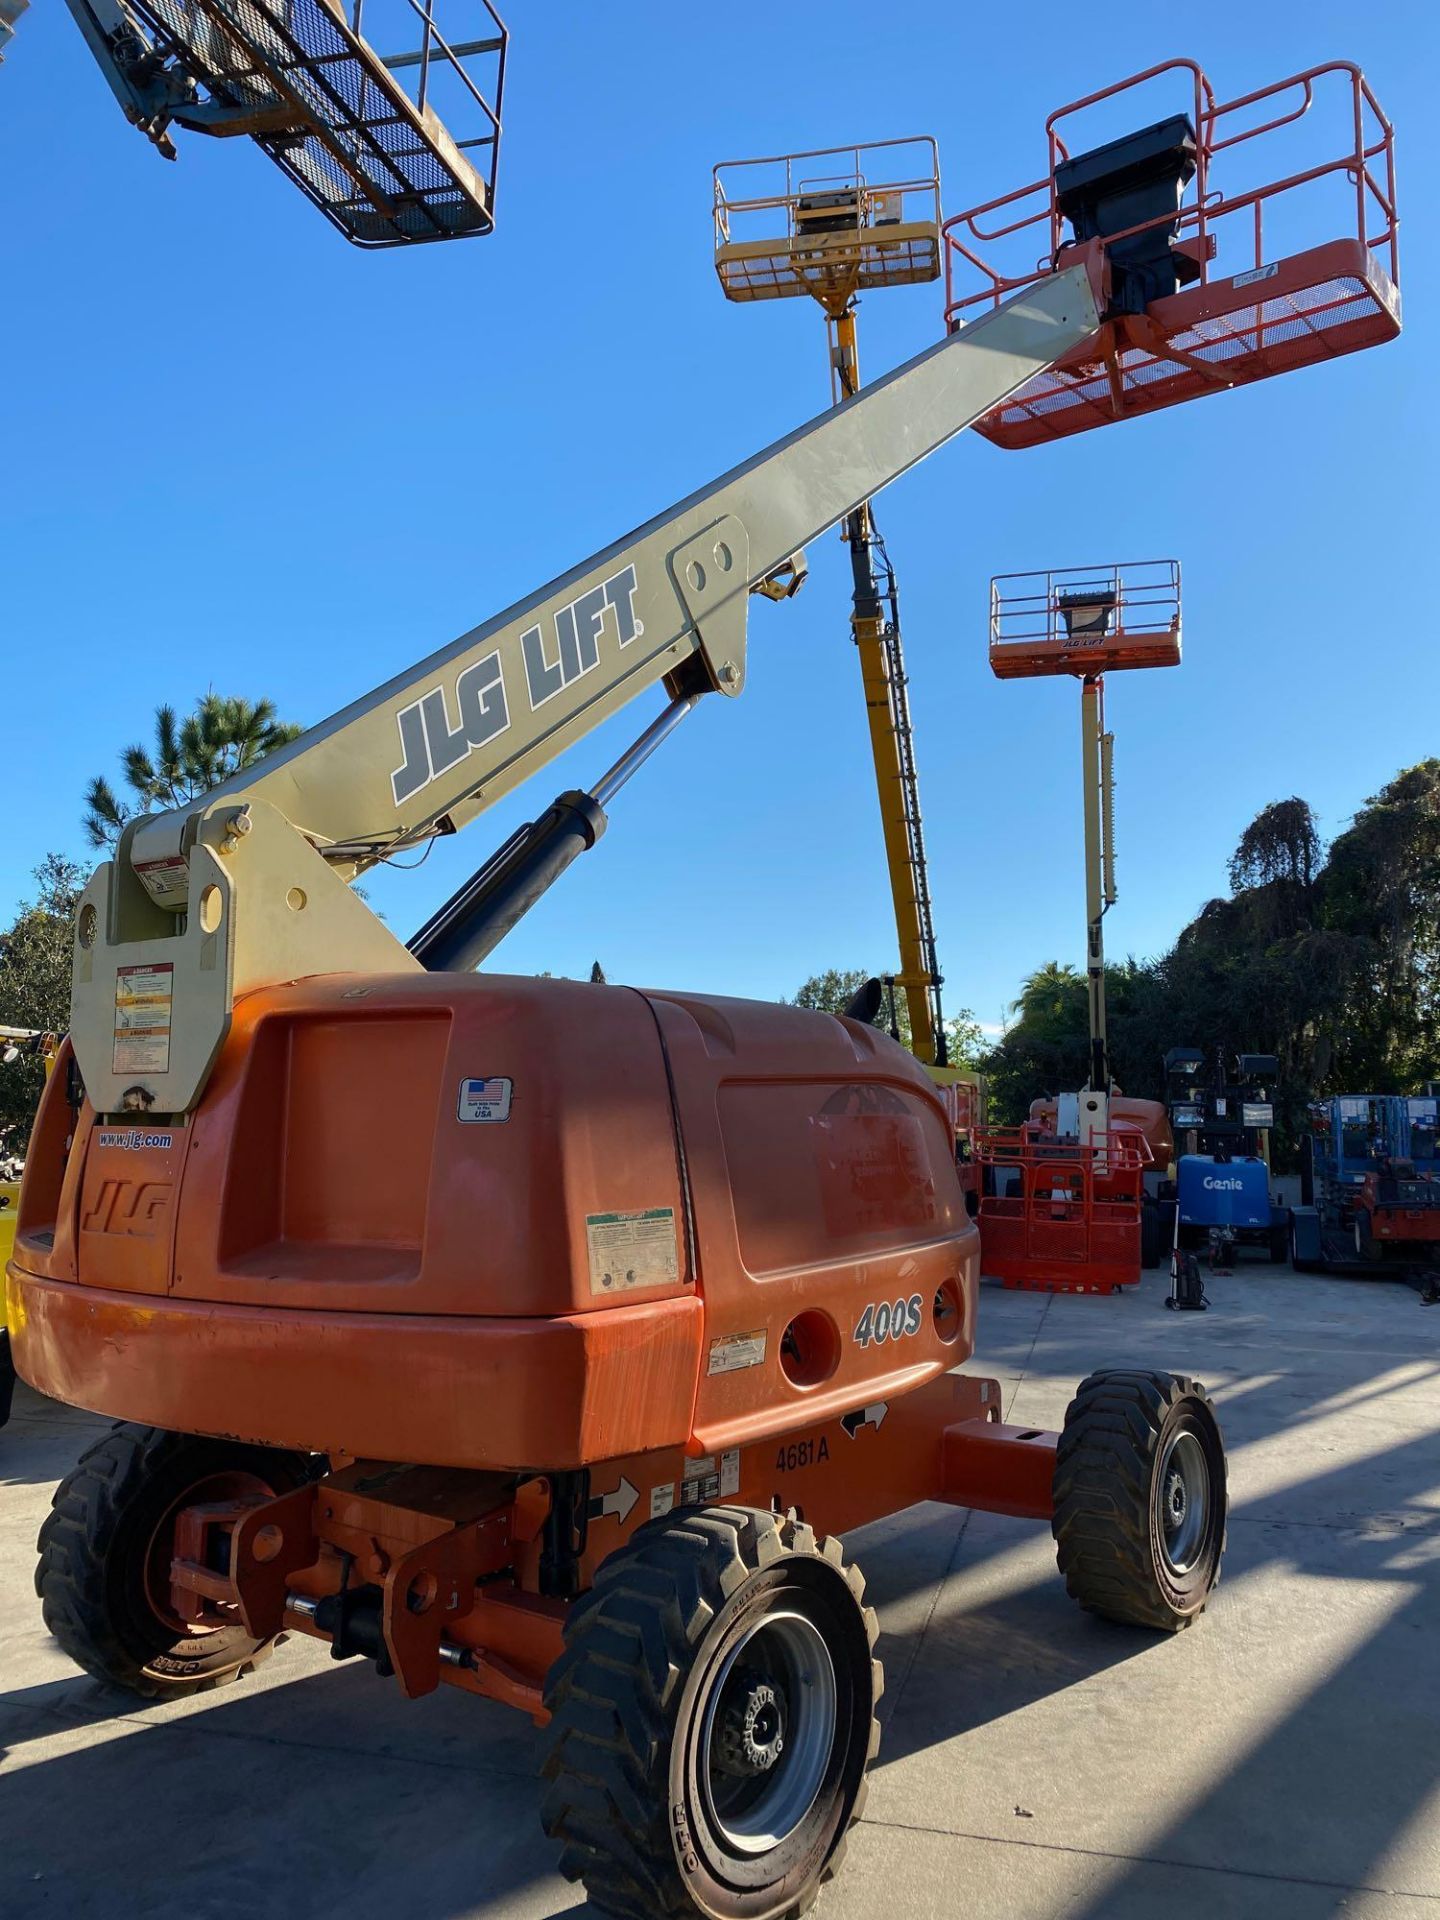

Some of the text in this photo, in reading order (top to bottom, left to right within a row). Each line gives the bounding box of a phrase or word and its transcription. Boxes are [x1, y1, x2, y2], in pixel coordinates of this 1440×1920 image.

[1062, 640, 1080, 648] JLG
[390, 649, 511, 808] JLG
[474, 1110, 492, 1118] USA
[100, 1130, 172, 1150] www.jlg.com
[1203, 1176, 1243, 1190] Genie
[82, 1180, 173, 1236] JLG
[853, 1293, 923, 1349] 400S
